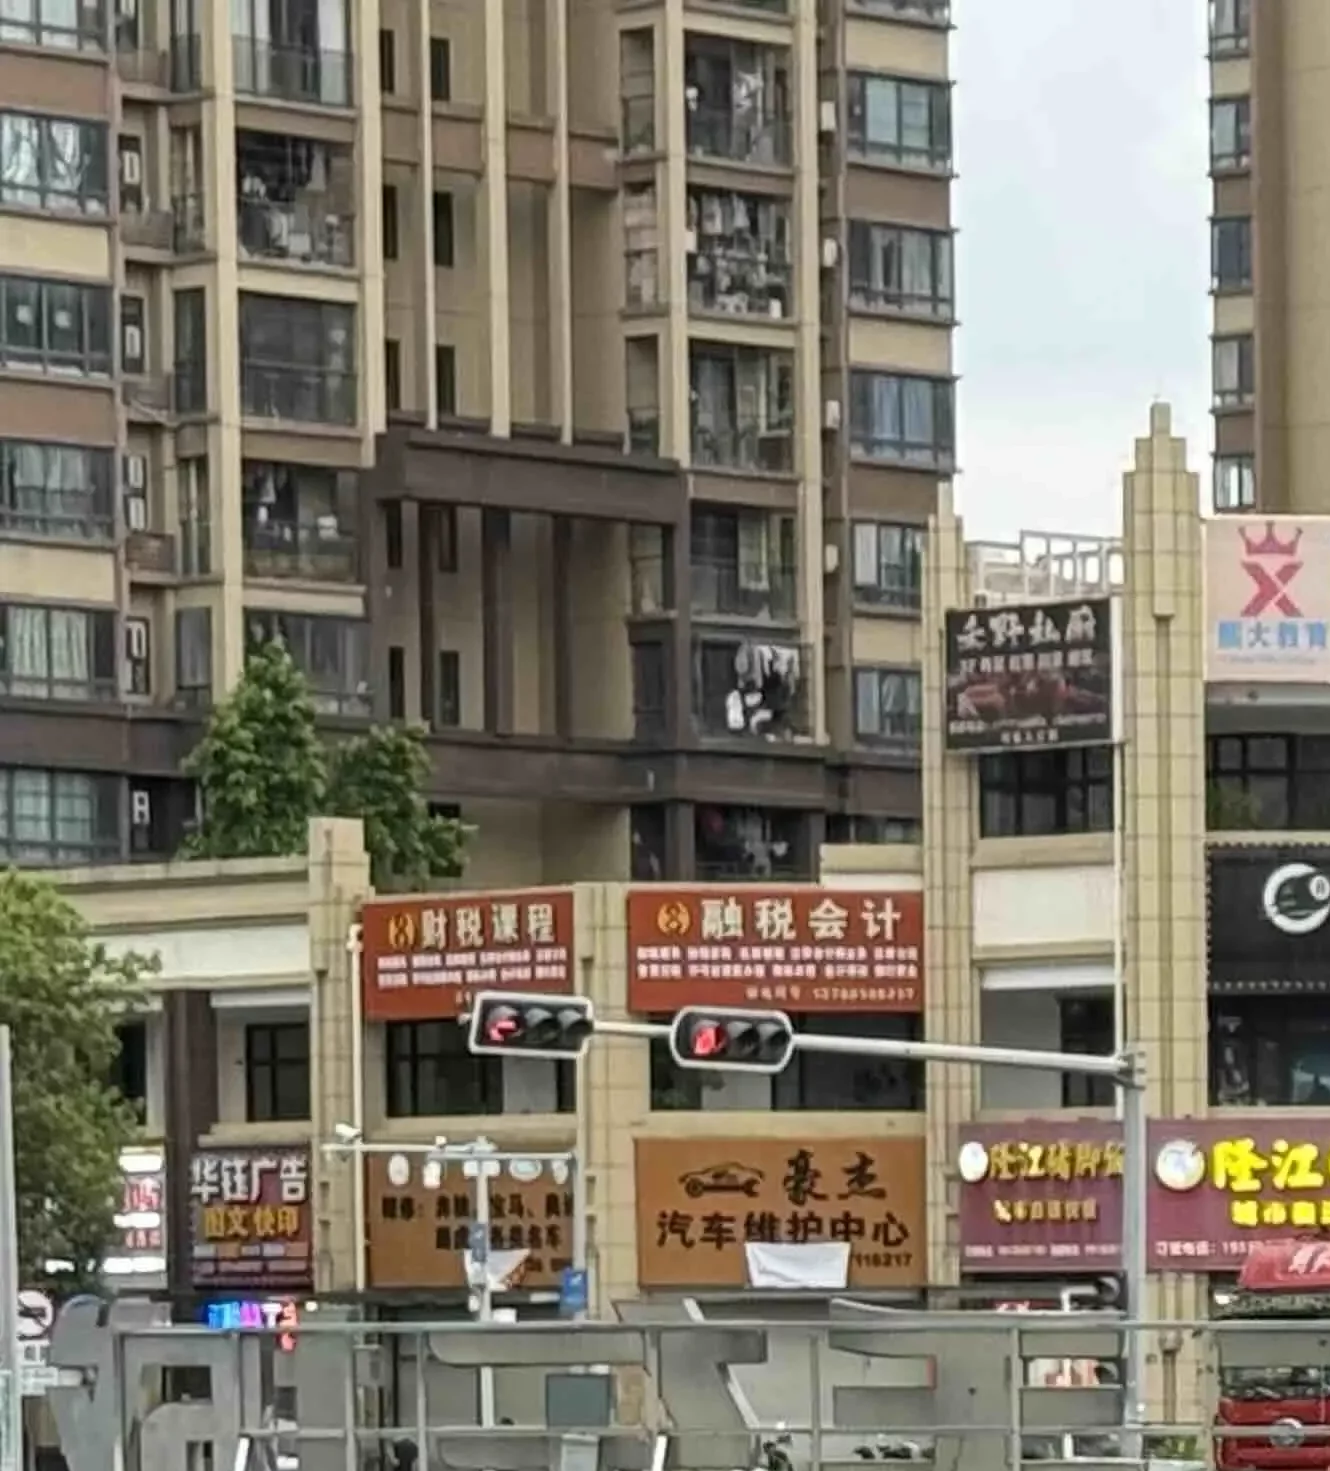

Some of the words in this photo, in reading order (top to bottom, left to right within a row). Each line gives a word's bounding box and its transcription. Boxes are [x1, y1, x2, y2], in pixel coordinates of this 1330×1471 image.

[701, 896, 902, 941] 融税会计
[784, 1148, 888, 1206] 豪杰
[204, 1204, 300, 1237] 图文快印
[656, 1210, 911, 1250] 汽车维护中心
